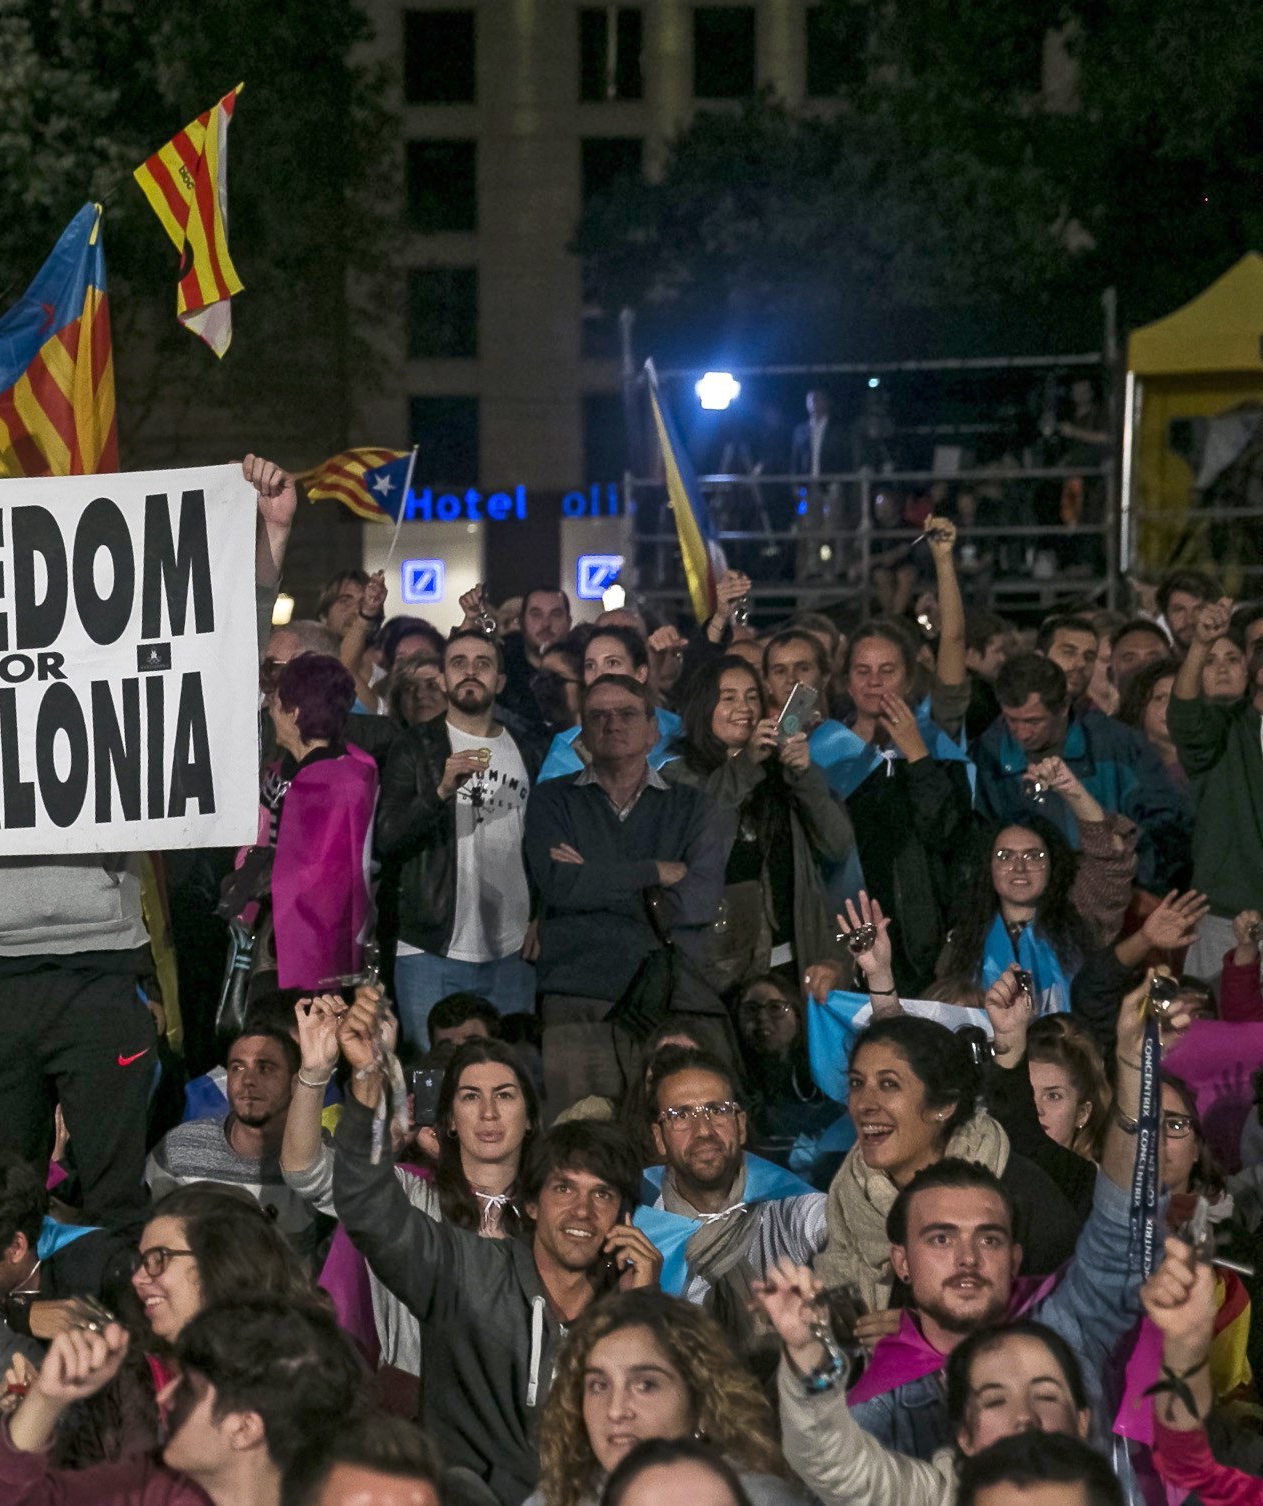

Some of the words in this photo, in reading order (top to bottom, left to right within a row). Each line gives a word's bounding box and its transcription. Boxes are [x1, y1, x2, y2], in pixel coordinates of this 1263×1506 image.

[178, 165, 195, 190] bloc
[404, 484, 527, 522] Hotel
[561, 483, 619, 518] oli
[1141, 1038, 1153, 1118] CONCENTRIX
[1133, 1128, 1149, 1208] CONCENTRIX
[1144, 1218, 1154, 1280] NCENTRIX
